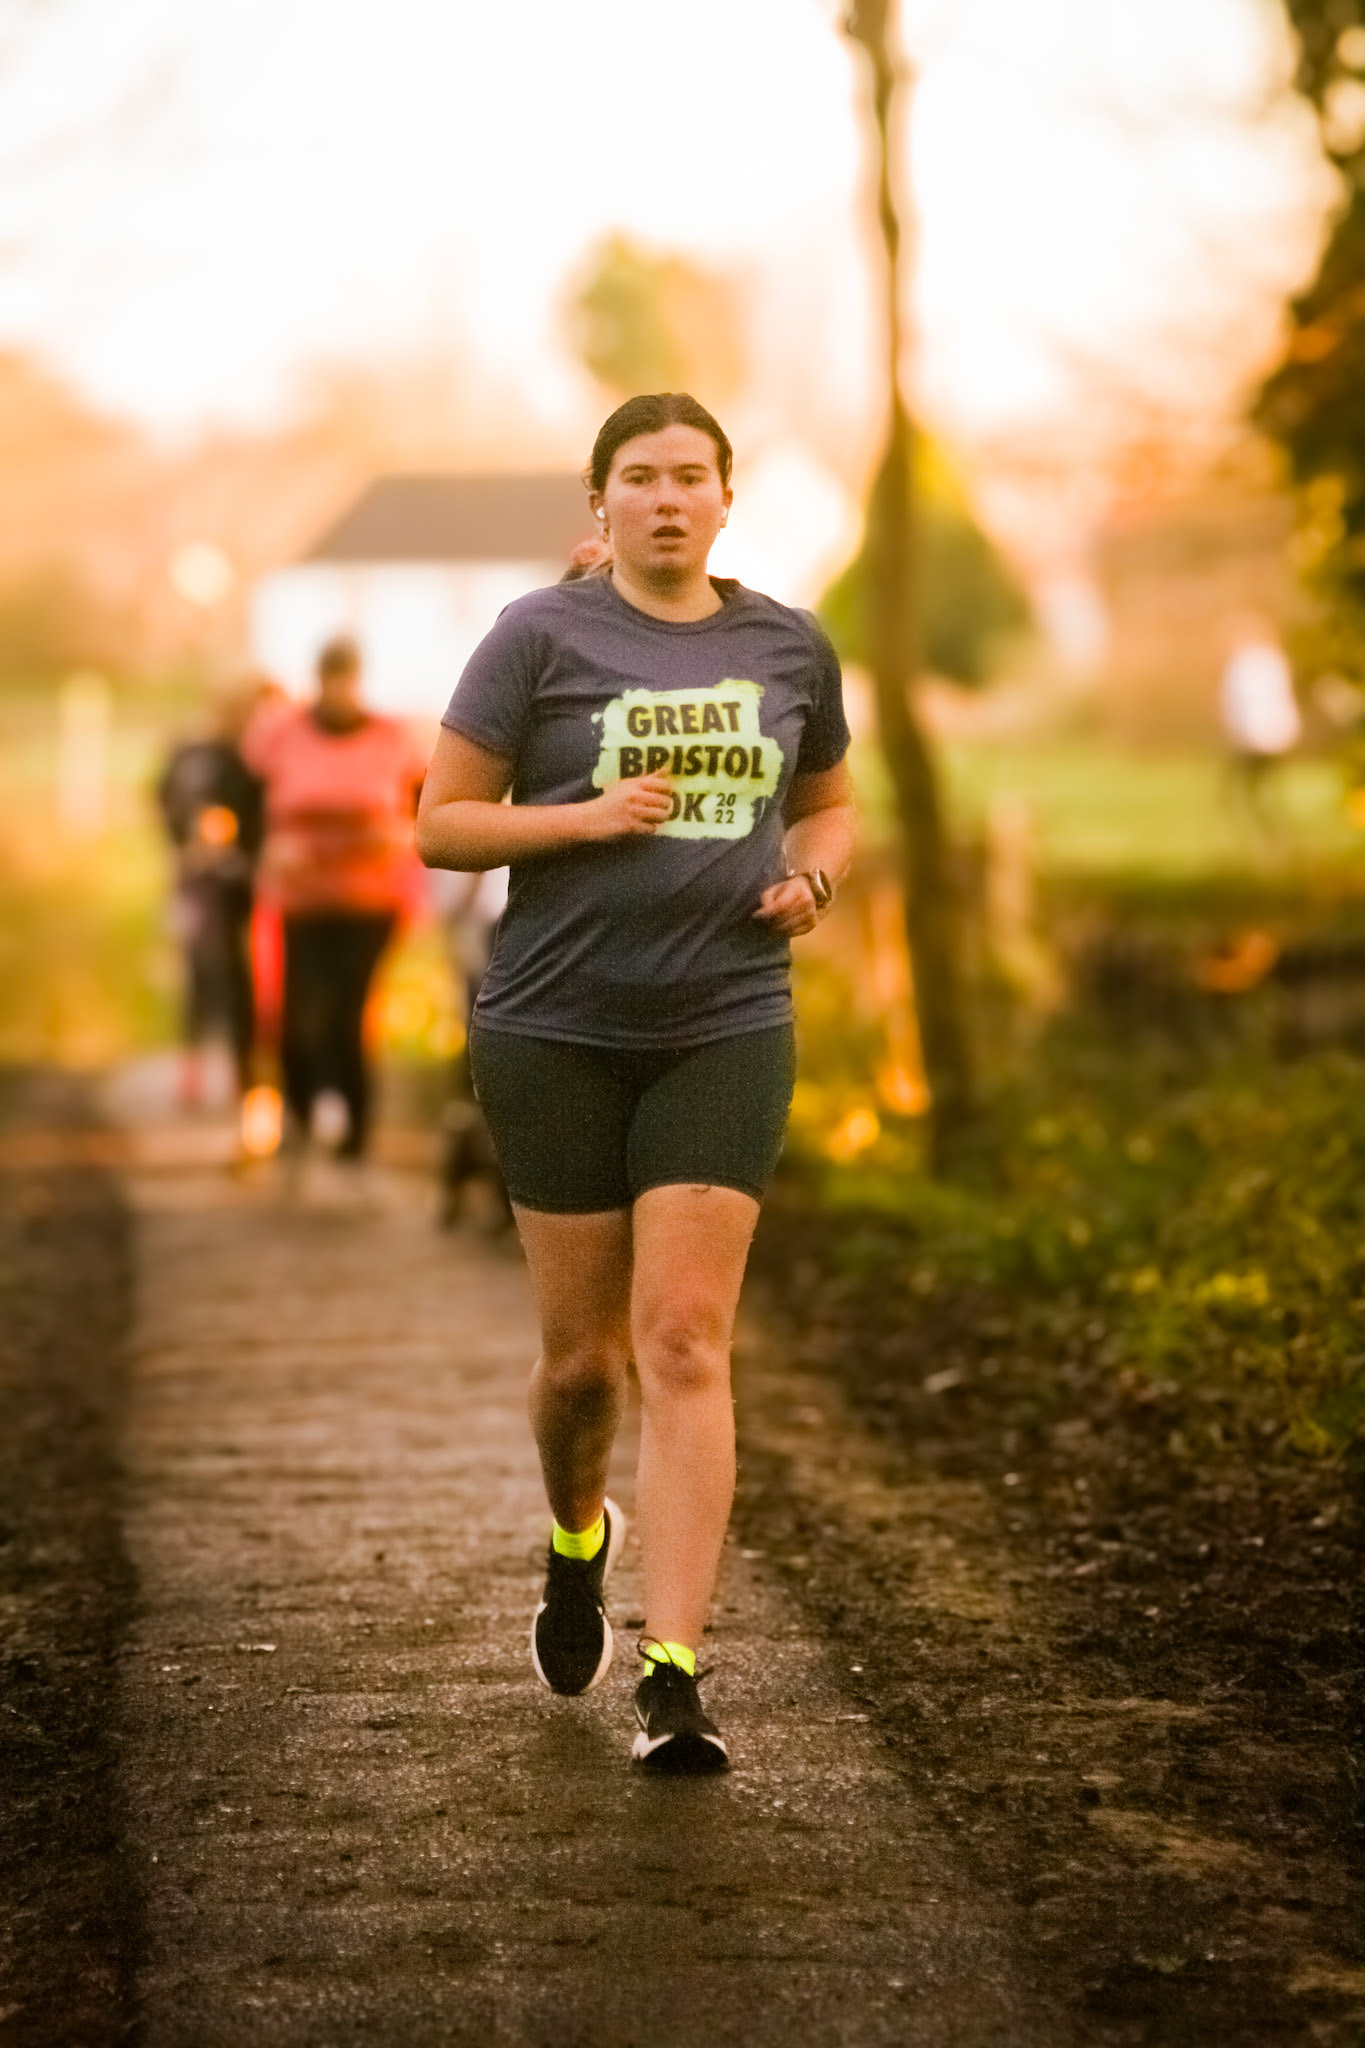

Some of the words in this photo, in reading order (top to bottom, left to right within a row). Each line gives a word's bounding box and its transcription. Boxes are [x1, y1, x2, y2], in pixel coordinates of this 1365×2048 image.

[627, 702, 741, 737] GREAT
[716, 793, 736, 807] 20
[715, 809, 735, 824] 22
